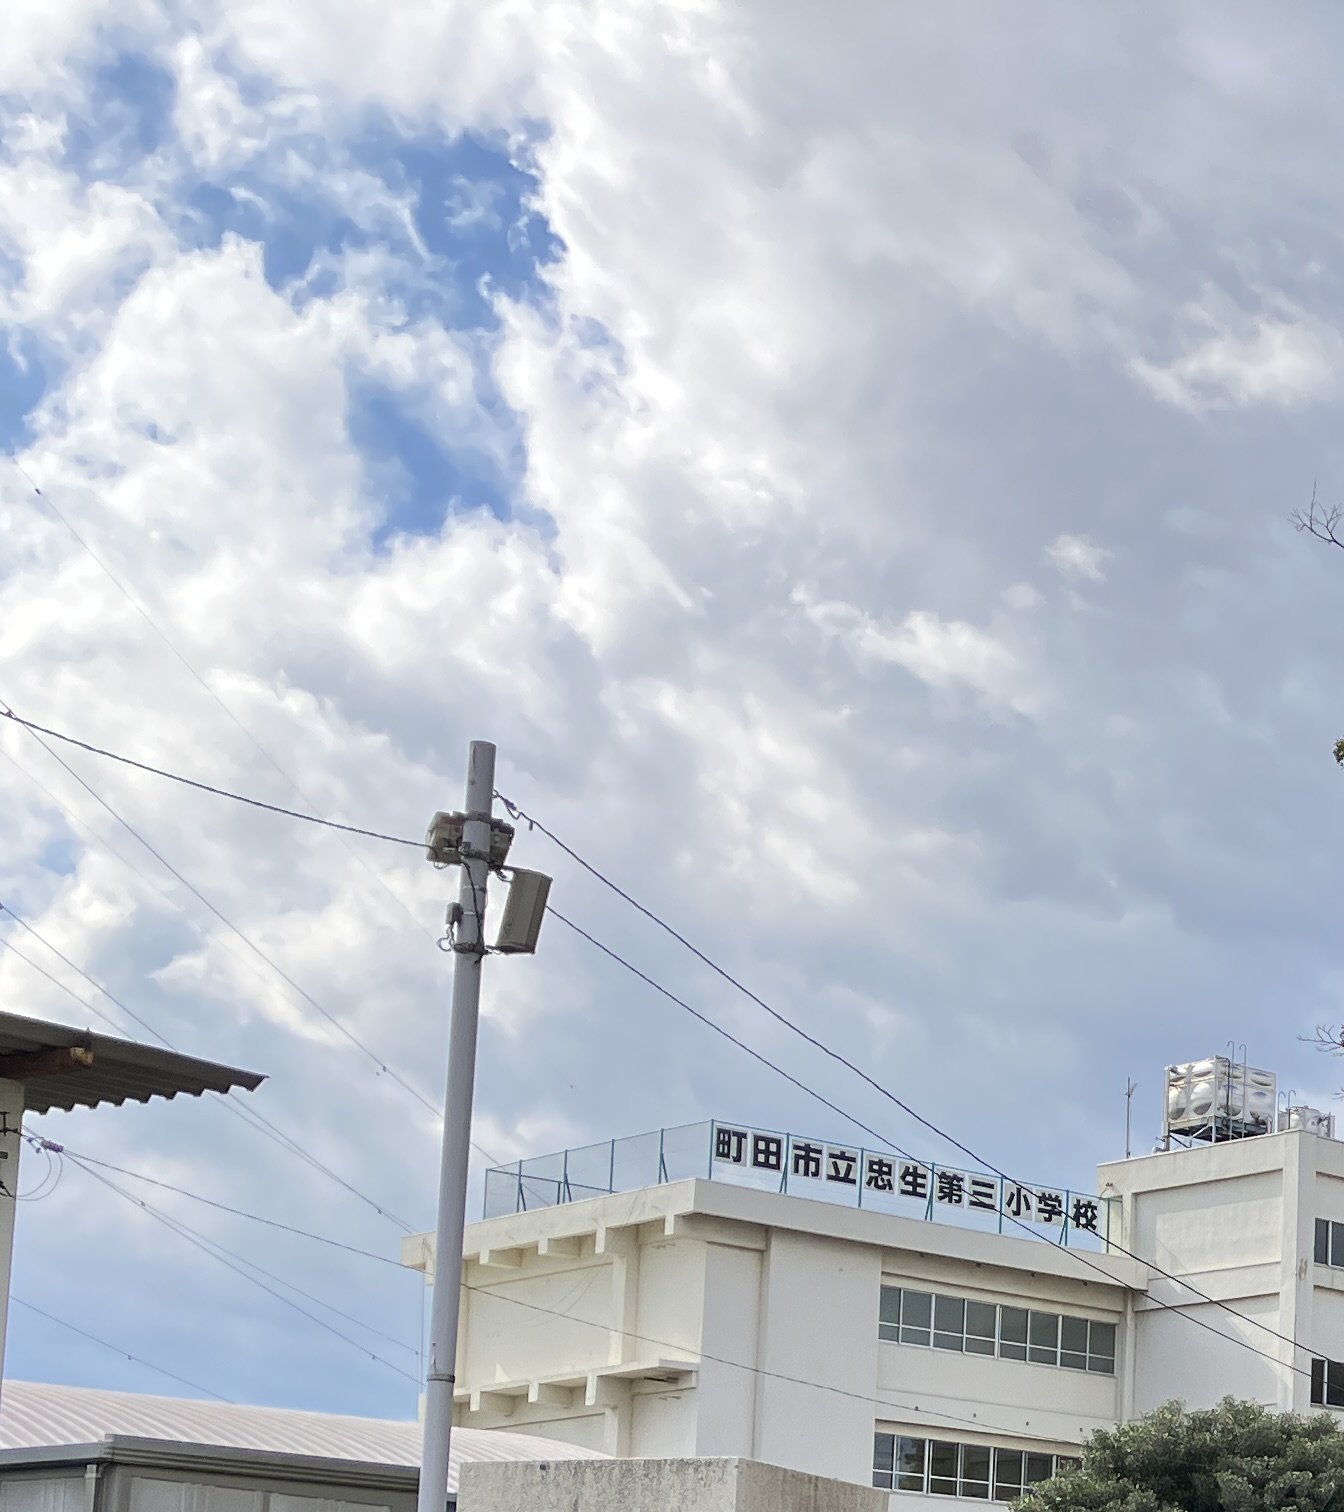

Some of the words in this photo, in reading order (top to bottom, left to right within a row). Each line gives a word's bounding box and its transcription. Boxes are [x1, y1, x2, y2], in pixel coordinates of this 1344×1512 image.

[715, 1127, 1099, 1231] 町田市立忠生第三小学校
